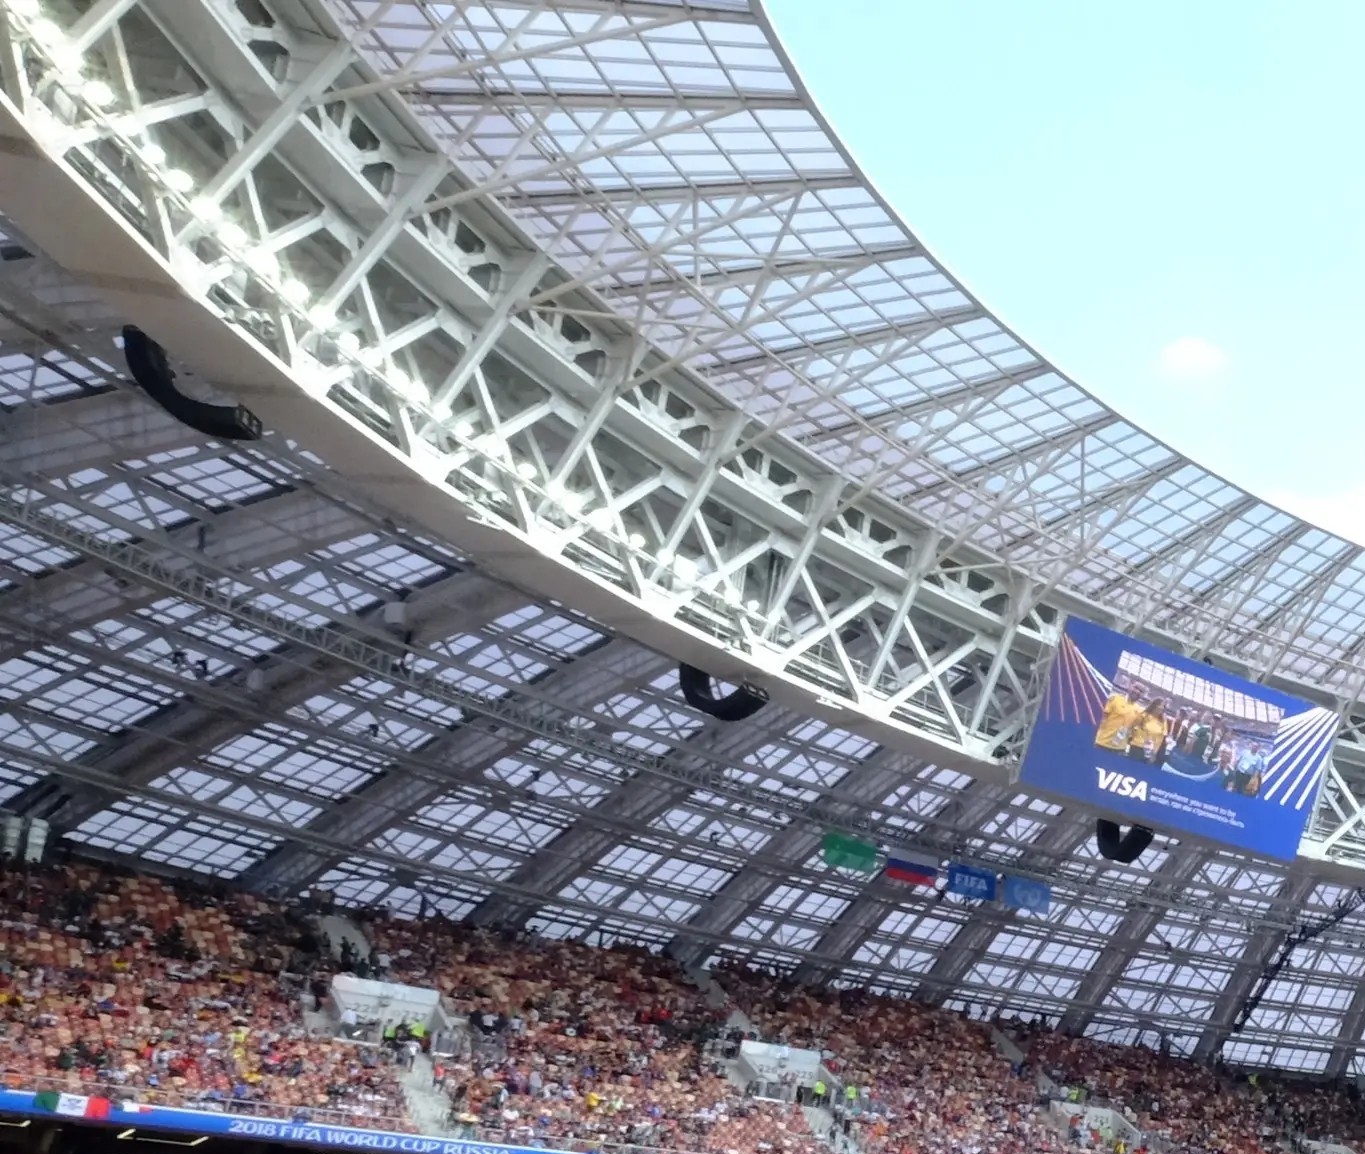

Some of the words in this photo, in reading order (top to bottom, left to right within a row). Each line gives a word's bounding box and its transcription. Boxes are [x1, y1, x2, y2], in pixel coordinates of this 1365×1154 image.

[1096, 767, 1148, 801] VISA
[954, 873, 988, 891] FIFA
[229, 1119, 276, 1138] 2018
[279, 1123, 322, 1143] FIFA
[326, 1130, 397, 1150] WORLD
[400, 1137, 441, 1154] CUP
